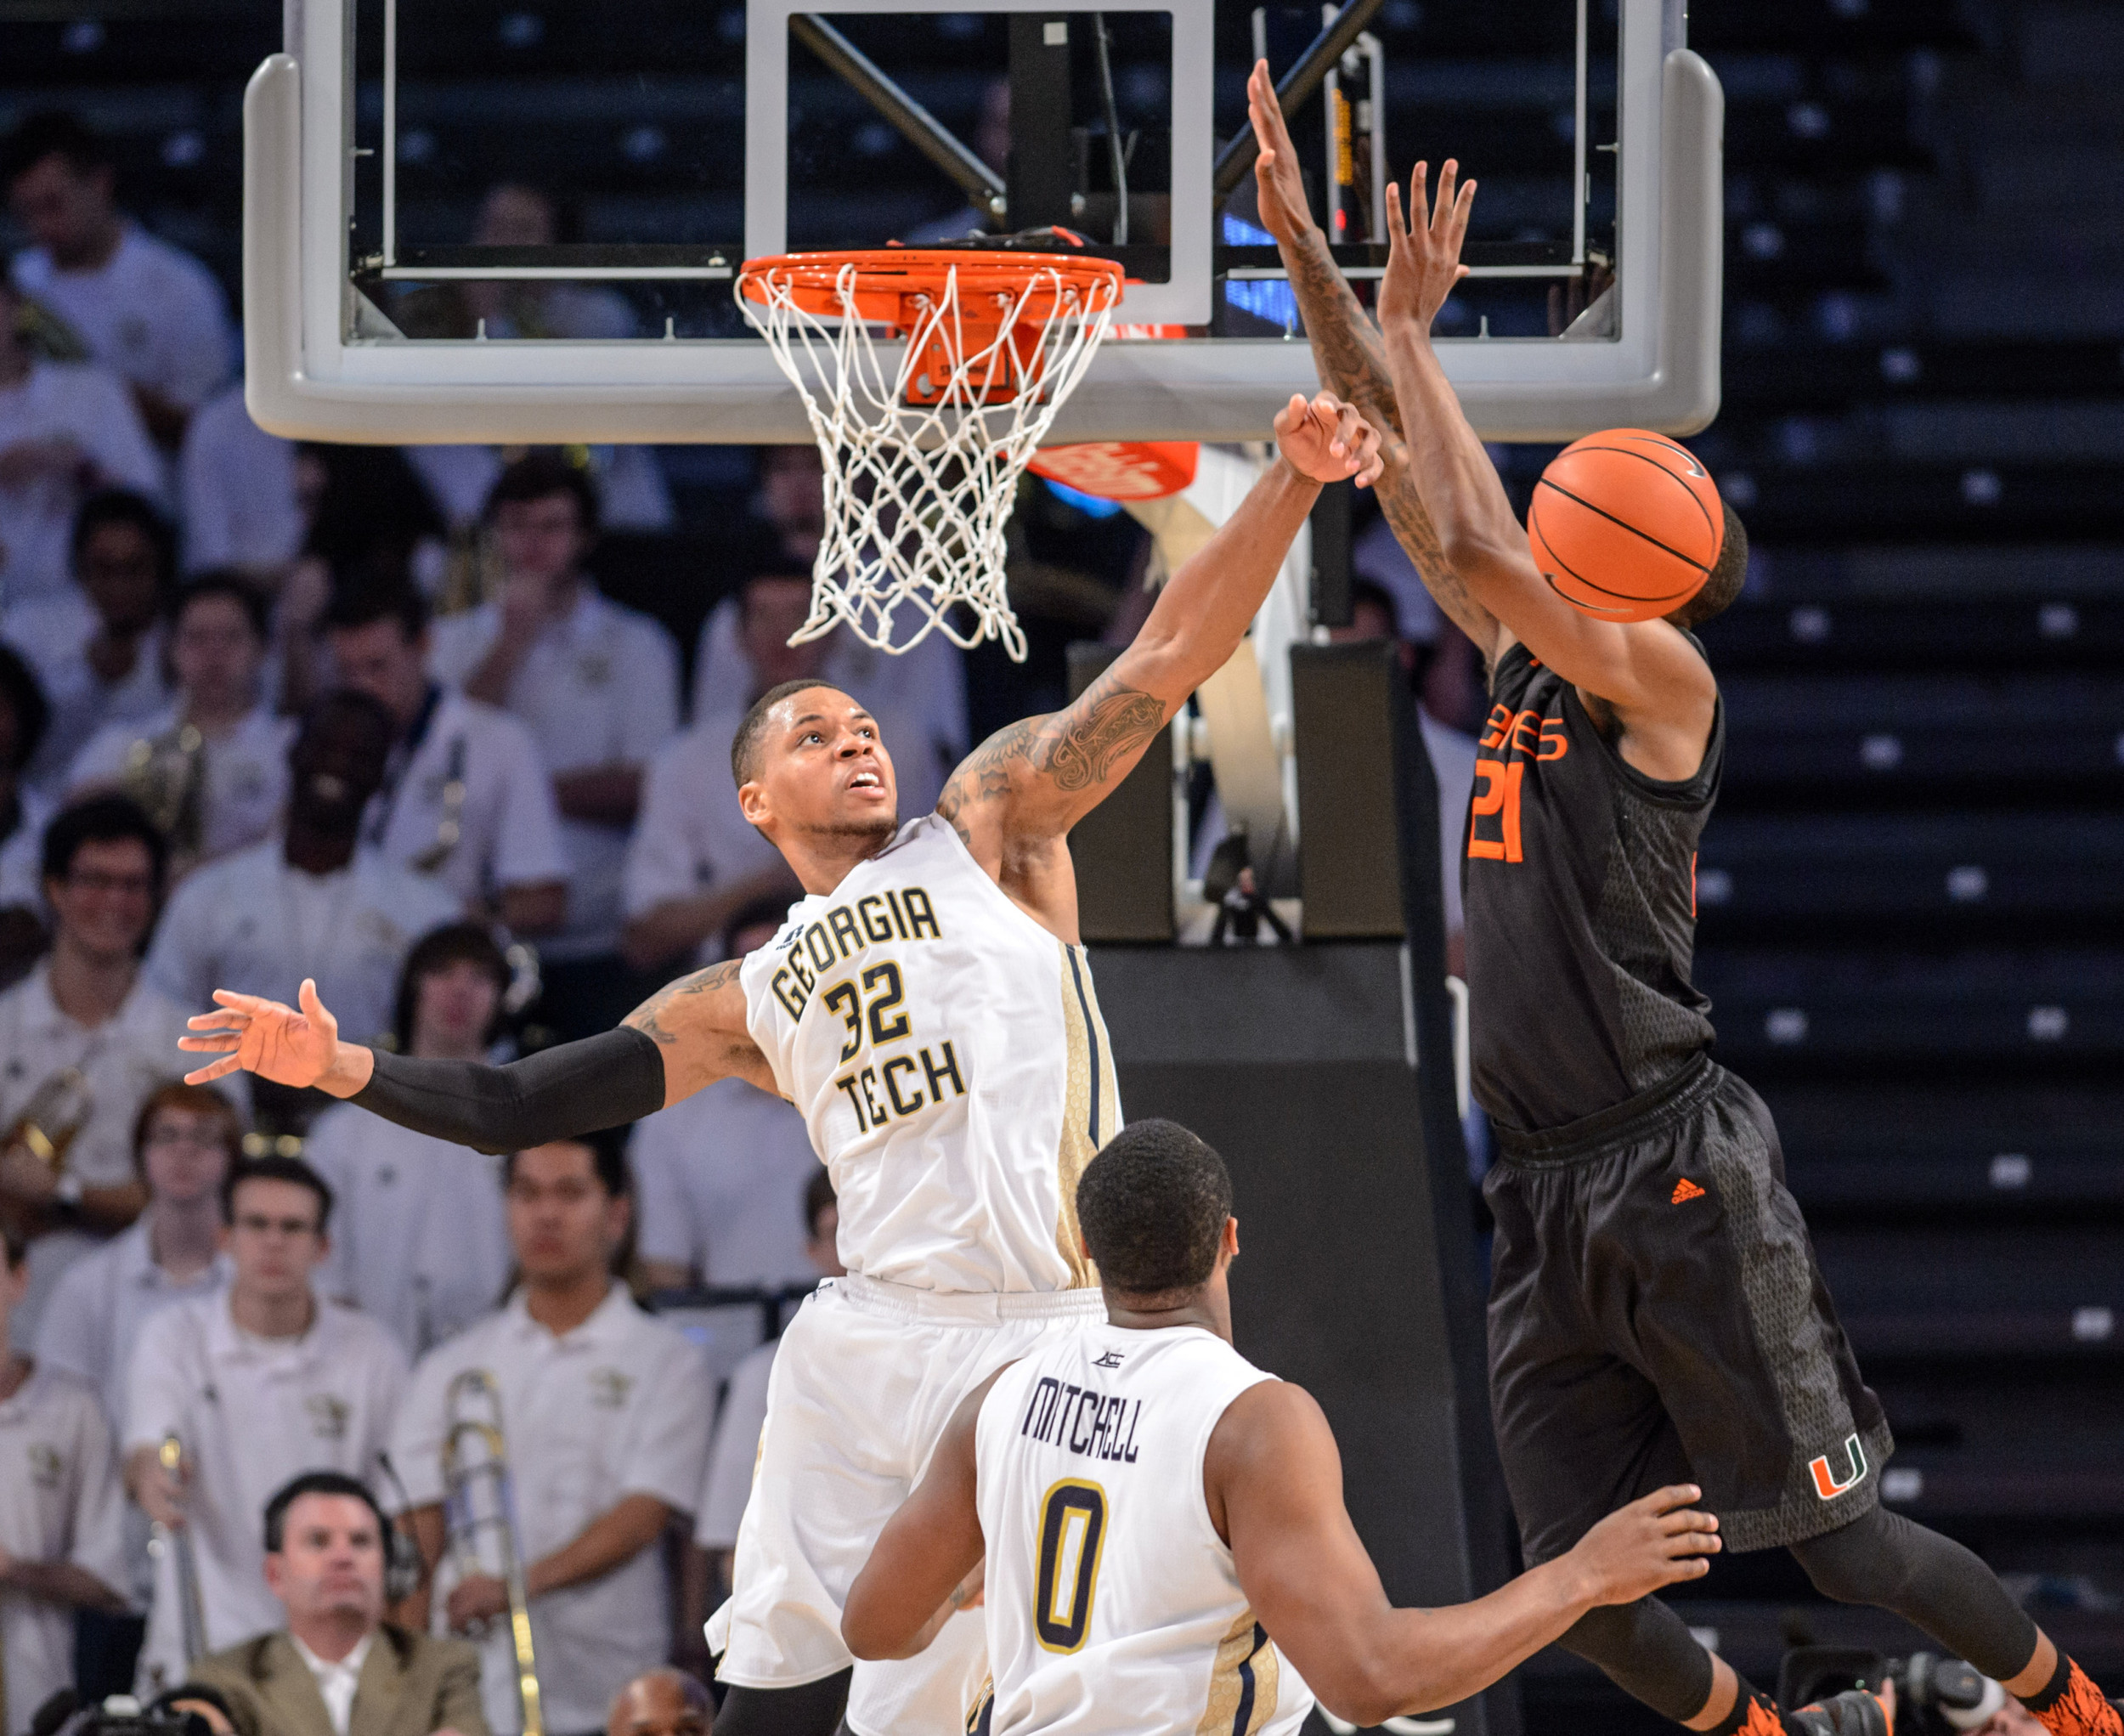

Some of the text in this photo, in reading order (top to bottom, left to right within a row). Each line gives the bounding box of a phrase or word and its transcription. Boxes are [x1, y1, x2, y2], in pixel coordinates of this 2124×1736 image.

[1467, 759, 1524, 862] 21
[771, 886, 943, 1024] GEORGIA
[820, 959, 912, 1067] 32
[836, 1040, 968, 1134] TECH
[1021, 1377, 1142, 1463] MITCHELL
[1809, 1433, 1867, 1501] U
[1033, 1477, 1109, 1655] 0
